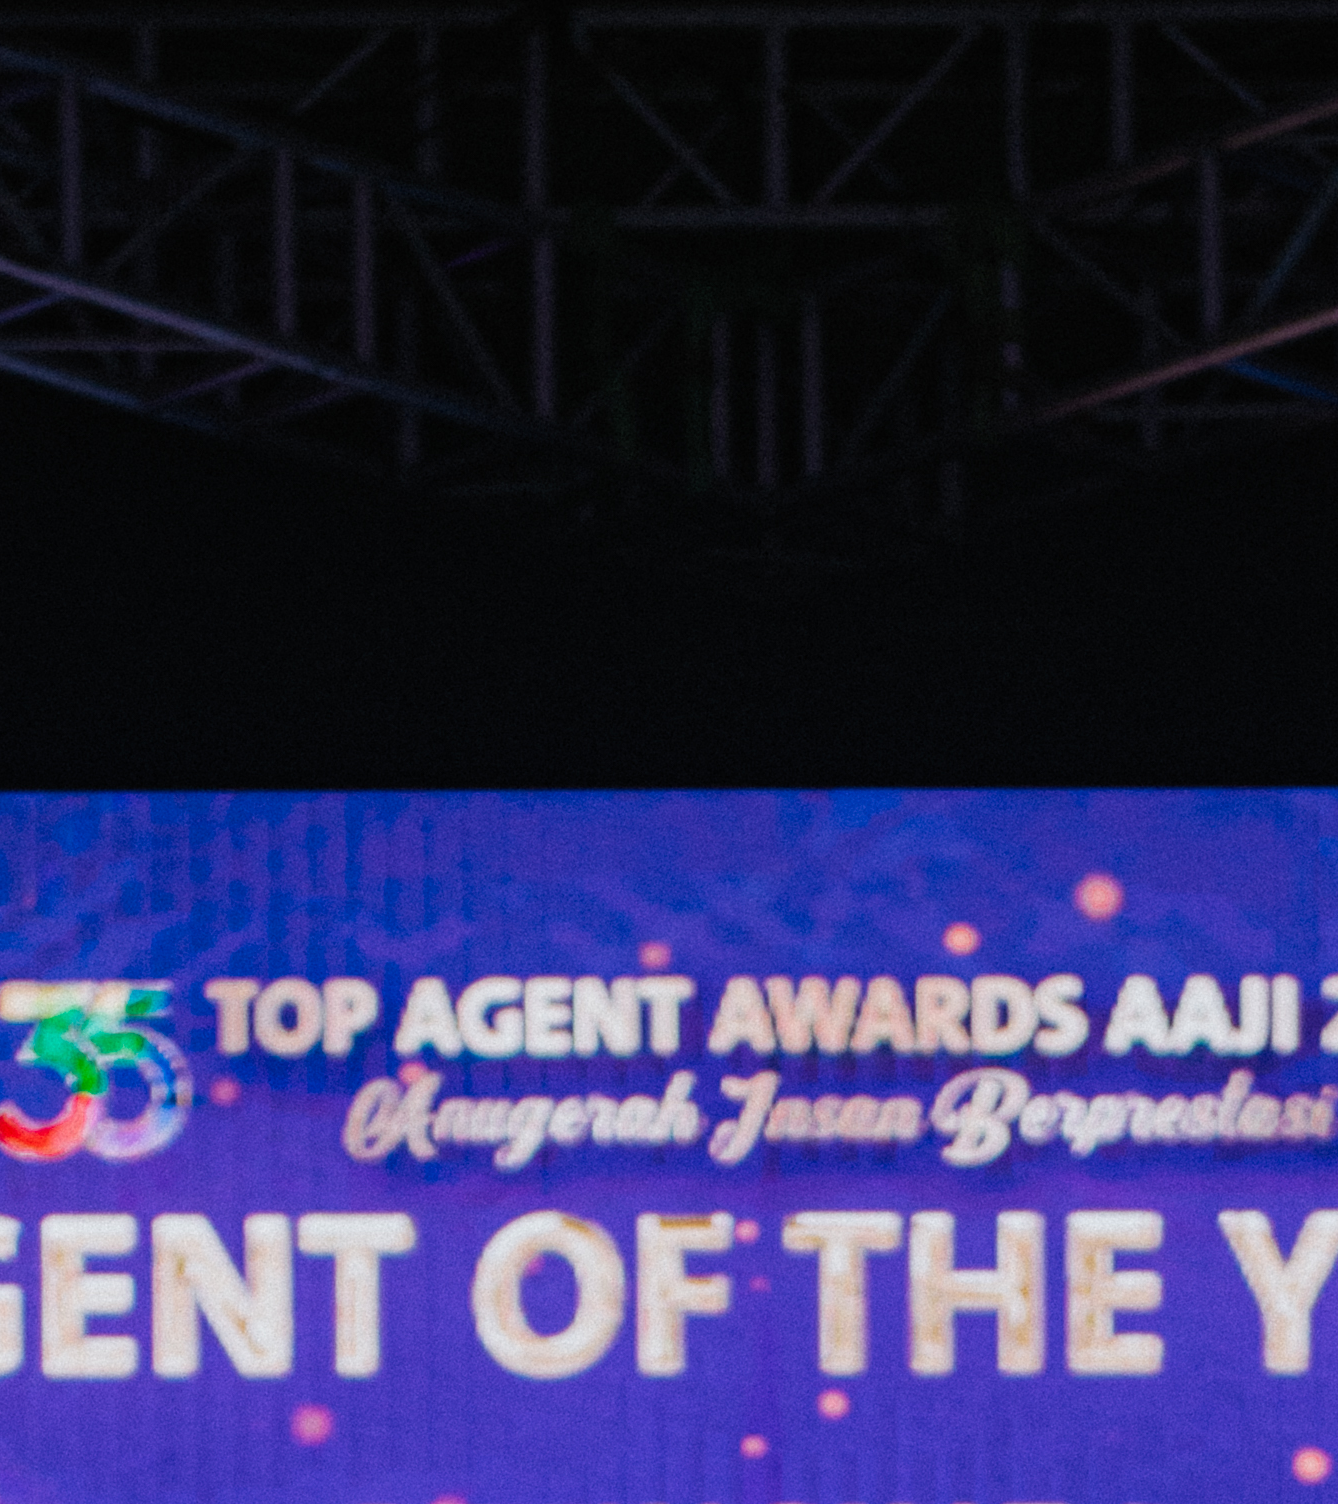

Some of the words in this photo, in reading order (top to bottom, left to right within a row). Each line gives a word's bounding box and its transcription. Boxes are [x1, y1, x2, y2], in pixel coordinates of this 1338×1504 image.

[205, 977, 380, 1056] TOP
[394, 977, 693, 1058] AGENT
[707, 975, 1089, 1056] AWARDS
[1103, 974, 1302, 1056] AAJI
[343, 1069, 702, 1170] Anugerah
[471, 1210, 753, 1379] OF
[781, 1210, 1165, 1376] THE
